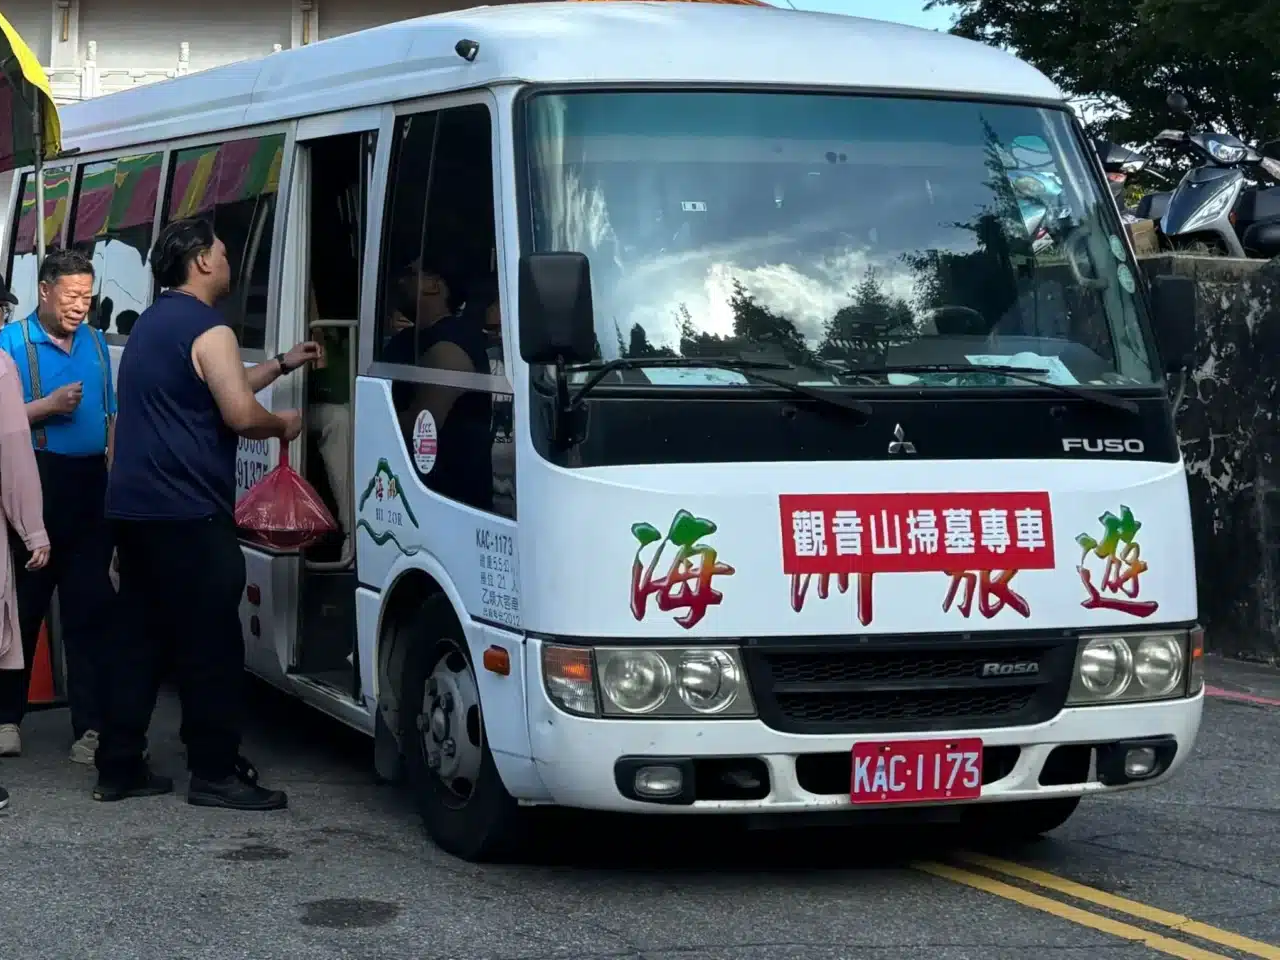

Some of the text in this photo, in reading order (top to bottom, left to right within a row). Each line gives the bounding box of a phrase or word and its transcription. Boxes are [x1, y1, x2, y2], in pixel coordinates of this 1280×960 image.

[1061, 438, 1145, 453] FUSO
[476, 528, 513, 556] KAC-1173
[791, 507, 1046, 557] 觀音山掃墓專車
